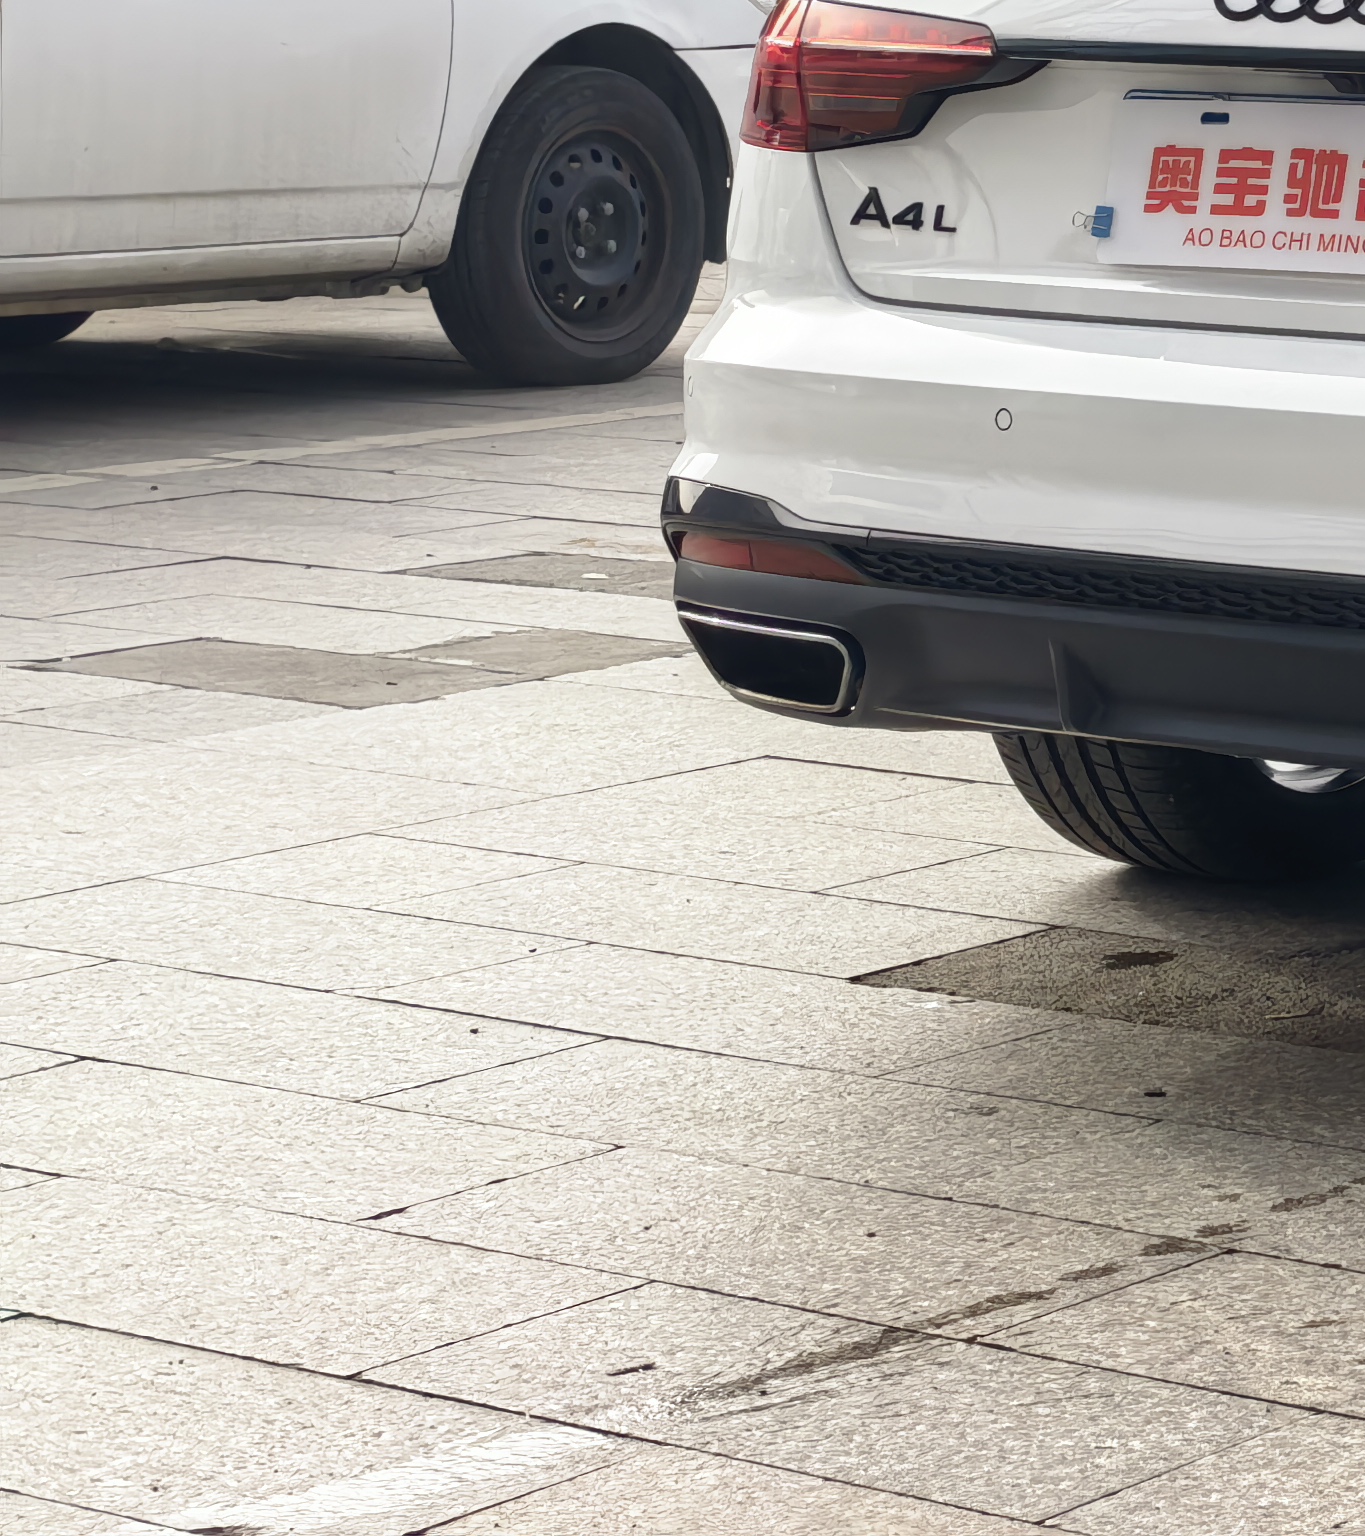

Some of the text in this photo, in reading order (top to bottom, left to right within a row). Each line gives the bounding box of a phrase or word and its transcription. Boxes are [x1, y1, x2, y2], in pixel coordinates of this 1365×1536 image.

[1182, 227, 1214, 248] AO
[1218, 228, 1266, 250] BAO
[1271, 231, 1311, 252] CHI
